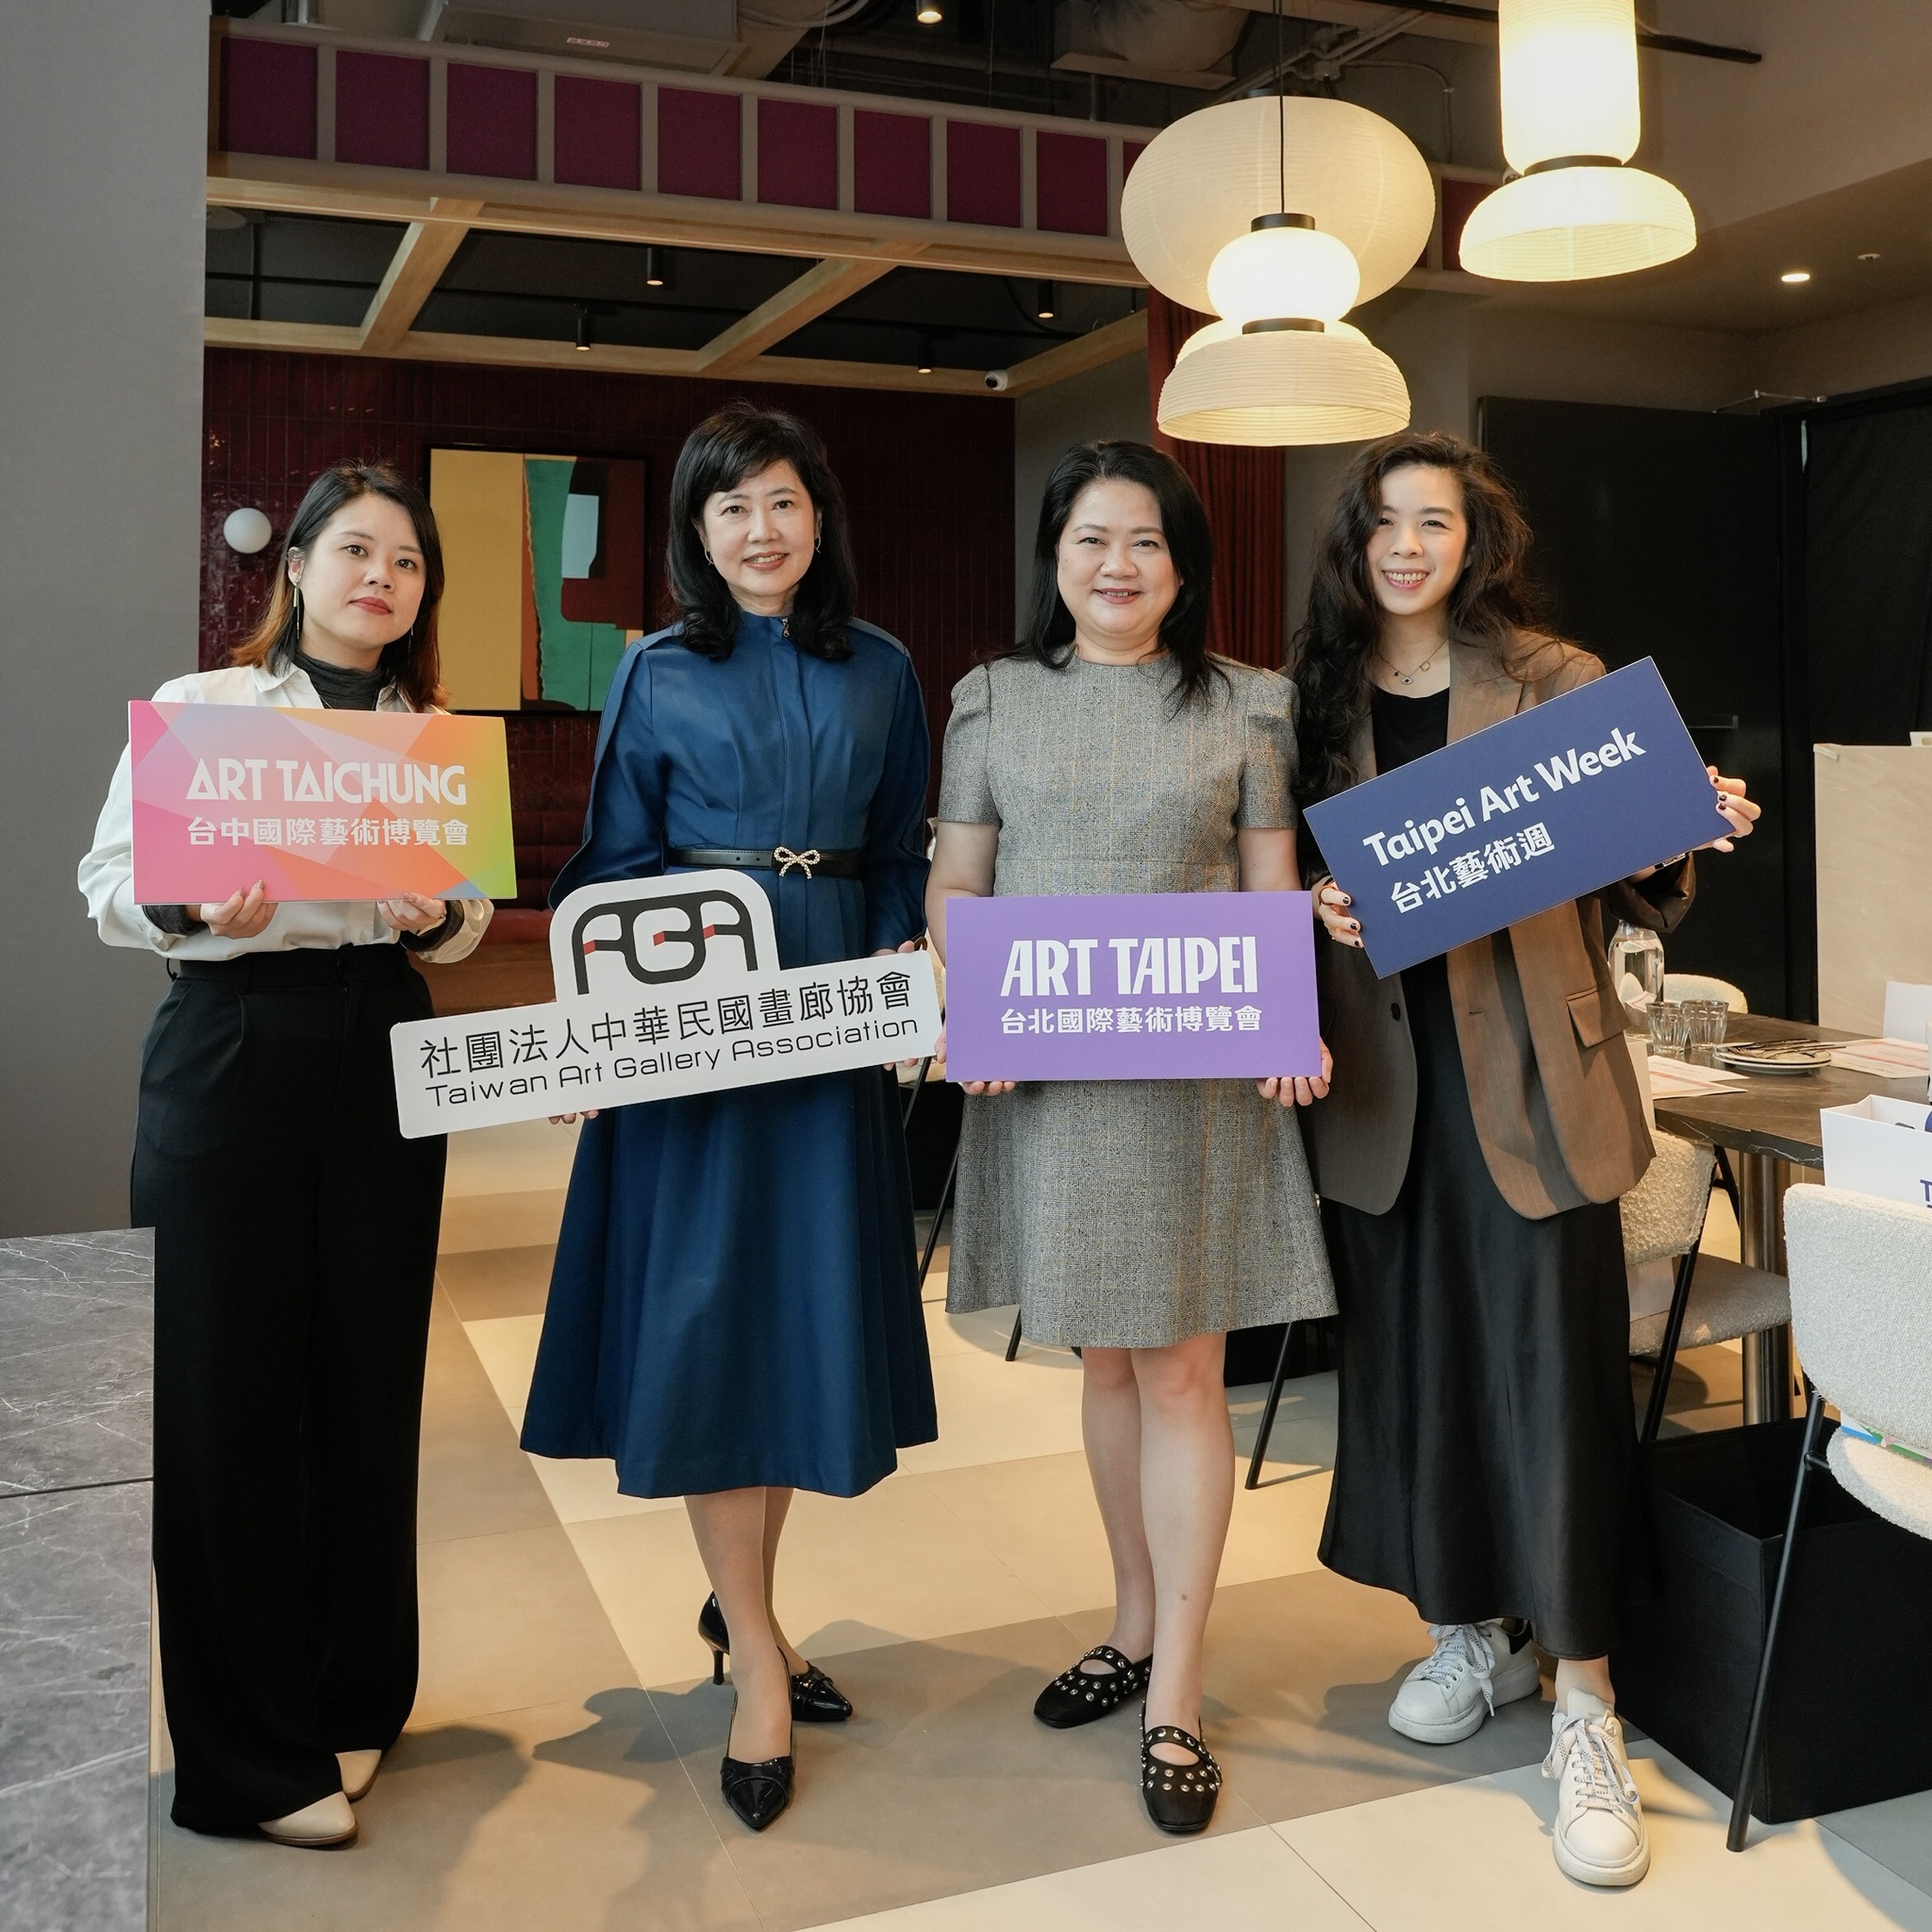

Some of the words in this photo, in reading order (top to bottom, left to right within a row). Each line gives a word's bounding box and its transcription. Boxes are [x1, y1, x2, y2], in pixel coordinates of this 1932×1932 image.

[186, 758, 267, 801] ART
[276, 760, 467, 805] TAICHUNG
[1363, 798, 1476, 865] Taipei
[1481, 775, 1541, 823] Art
[1534, 728, 1646, 791] Week
[188, 816, 469, 846] 台中國際藝術博覽會
[1391, 823, 1555, 913] 台北藝術週
[1000, 939, 1098, 996] ART
[1108, 937, 1257, 994] TAIPEI
[421, 972, 911, 1077] 社團法人中華民國畫廊協會
[1001, 1006, 1262, 1034] 台北國際藝術博覽會
[425, 1075, 548, 1107] Taiwan
[559, 1062, 603, 1089] Art
[614, 1049, 721, 1079] Gallery
[732, 1019, 918, 1061] Association
